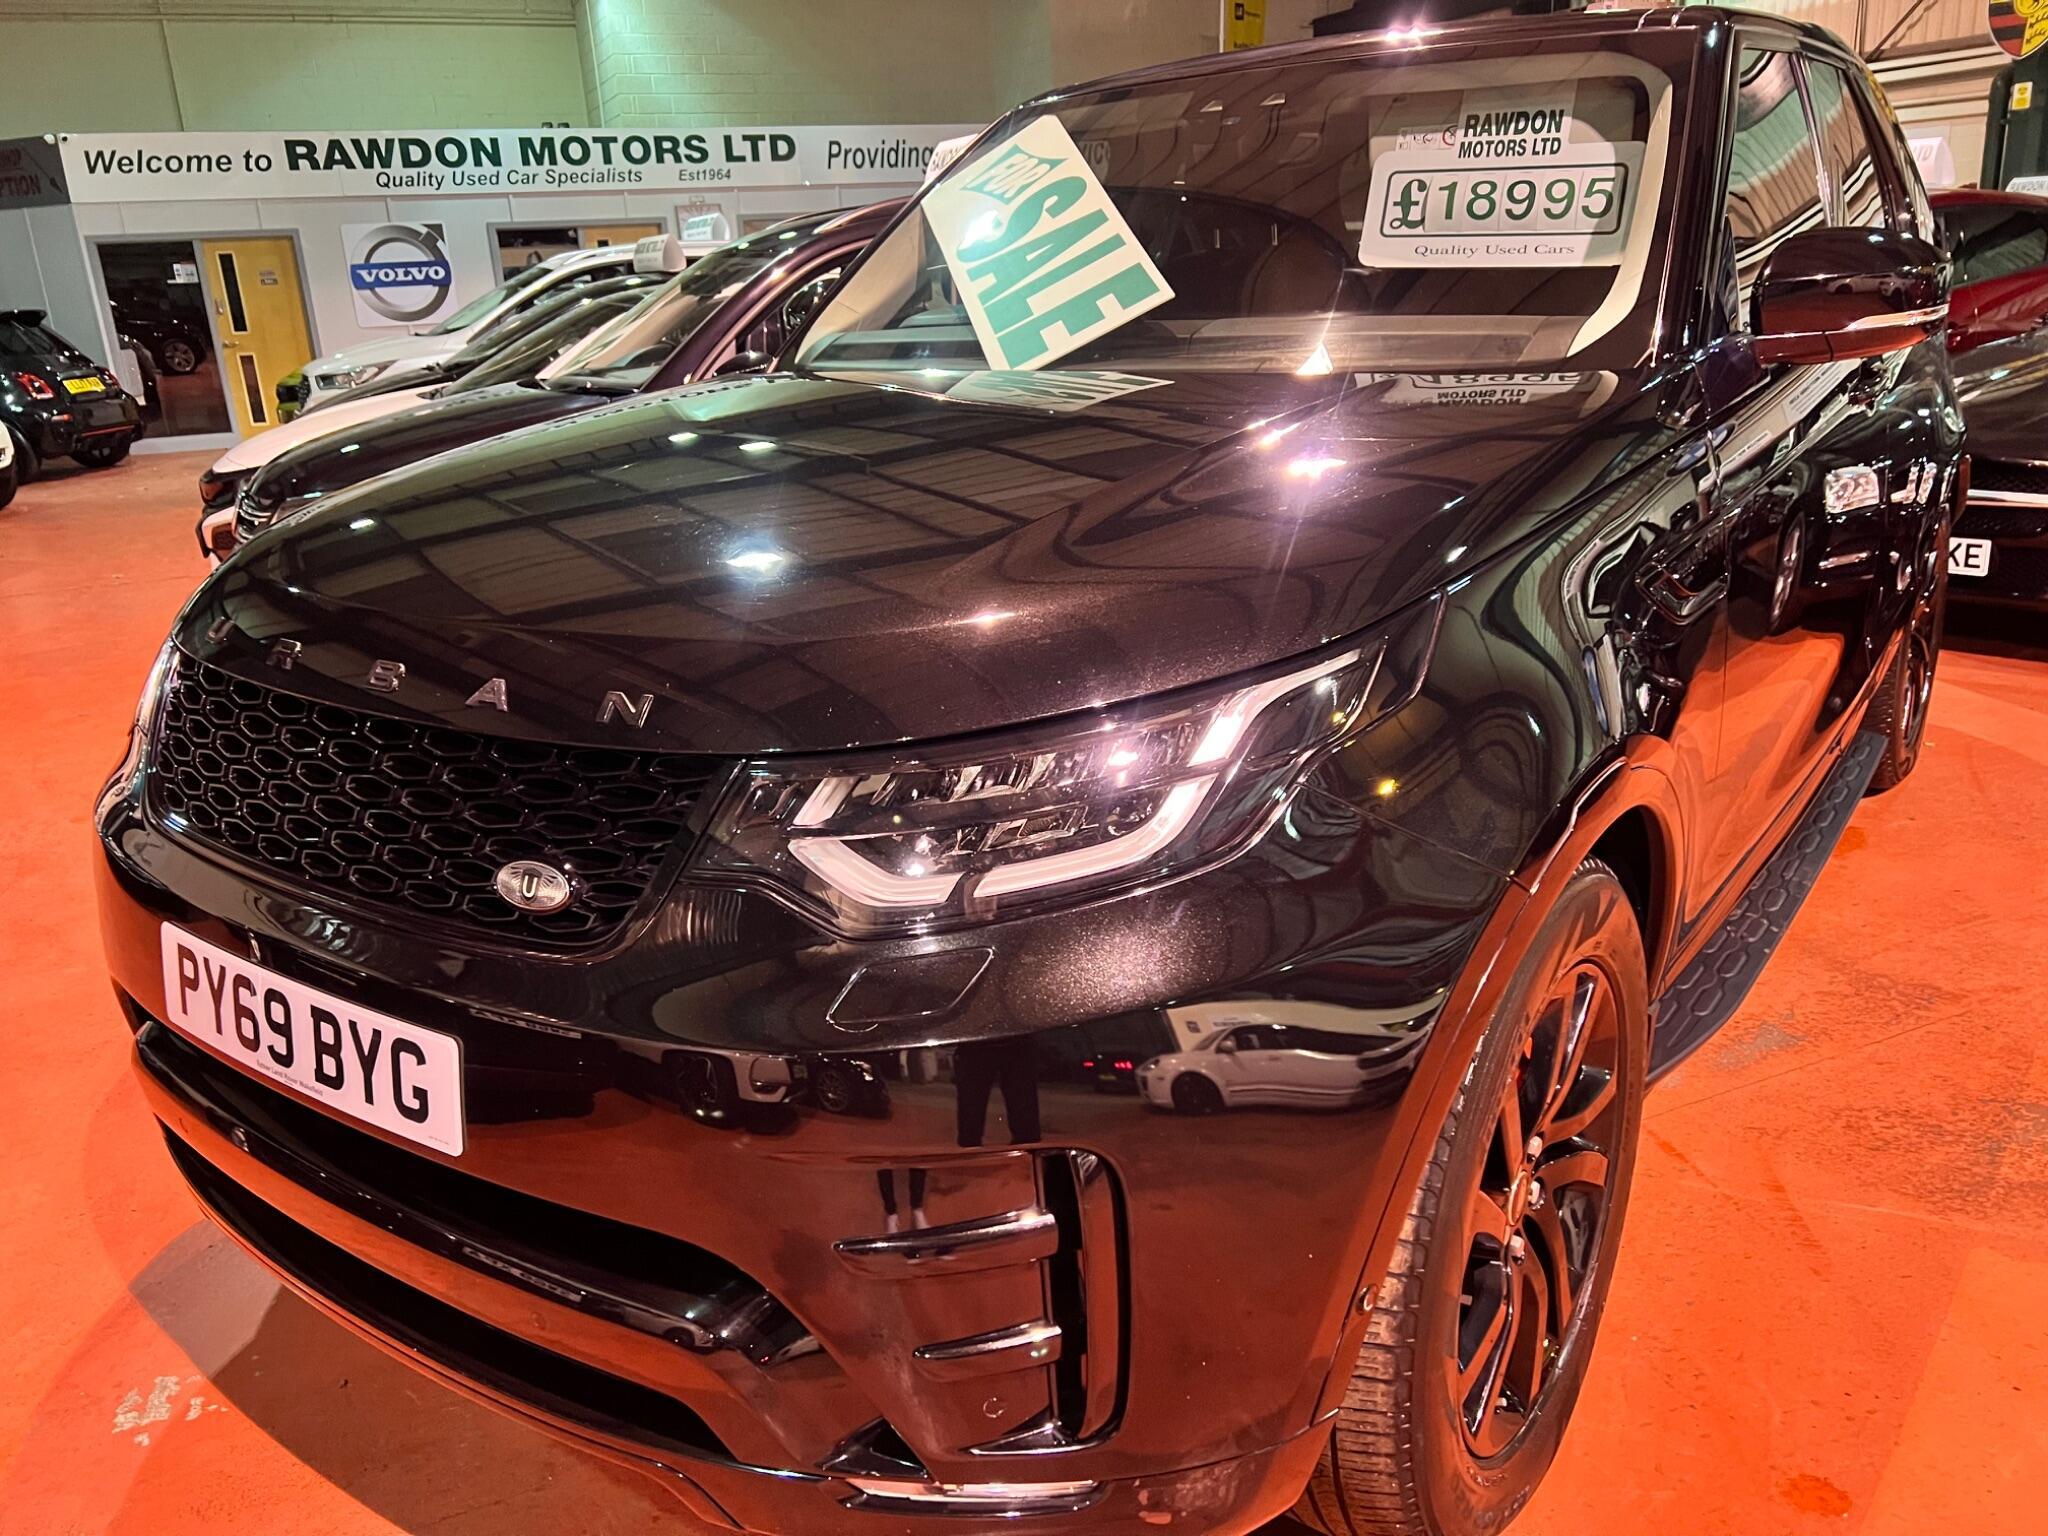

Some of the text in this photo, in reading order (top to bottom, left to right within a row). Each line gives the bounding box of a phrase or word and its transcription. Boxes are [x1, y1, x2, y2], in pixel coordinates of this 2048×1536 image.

[1463, 108, 1565, 137] RAWDON
[84, 133, 796, 174] Welcome to RAWDON MOTORS LTD
[828, 139, 937, 174] Providing
[1458, 138, 1527, 159] MOTORS
[1531, 136, 1563, 157] LTD
[376, 167, 643, 190] Quality Used Car Specialists
[678, 168, 732, 182] Est1964
[964, 152, 1051, 199] FOR
[1390, 176, 1617, 229] £18995
[1414, 243, 1575, 259] Quality Used Cars
[355, 264, 446, 283] VOLVO
[956, 175, 1161, 369] SALE
[522, 874, 538, 898] U
[176, 943, 430, 1124] PY69 BYG
